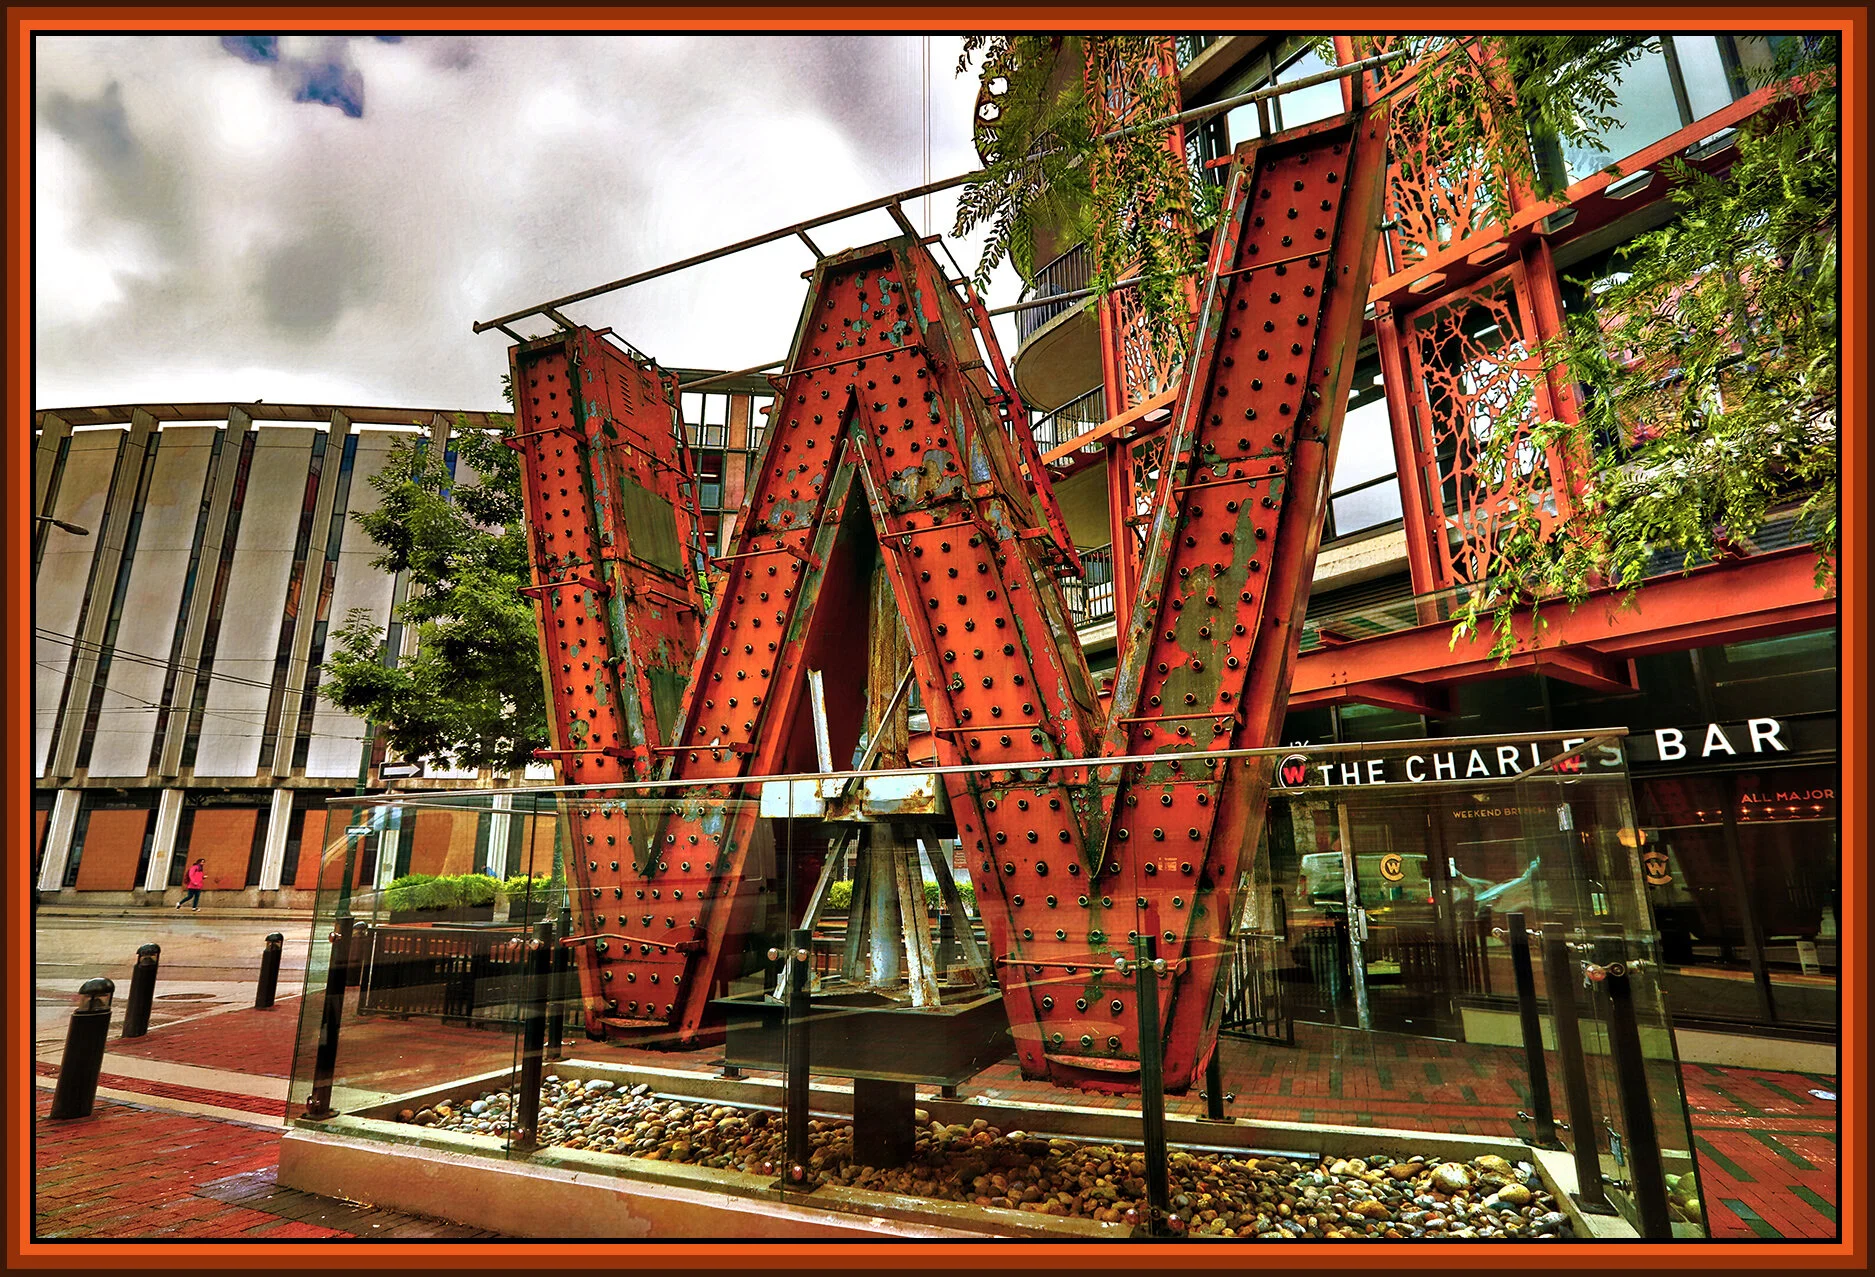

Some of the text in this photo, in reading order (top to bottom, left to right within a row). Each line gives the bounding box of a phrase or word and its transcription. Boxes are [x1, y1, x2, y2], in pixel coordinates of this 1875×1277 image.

[1317, 759, 1386, 787] THE
[1404, 737, 1623, 783] CHARLES
[1654, 717, 1786, 762] BAR
[1741, 788, 1835, 804] ALL MAJOR
[1452, 808, 1502, 819] WEEKEND
